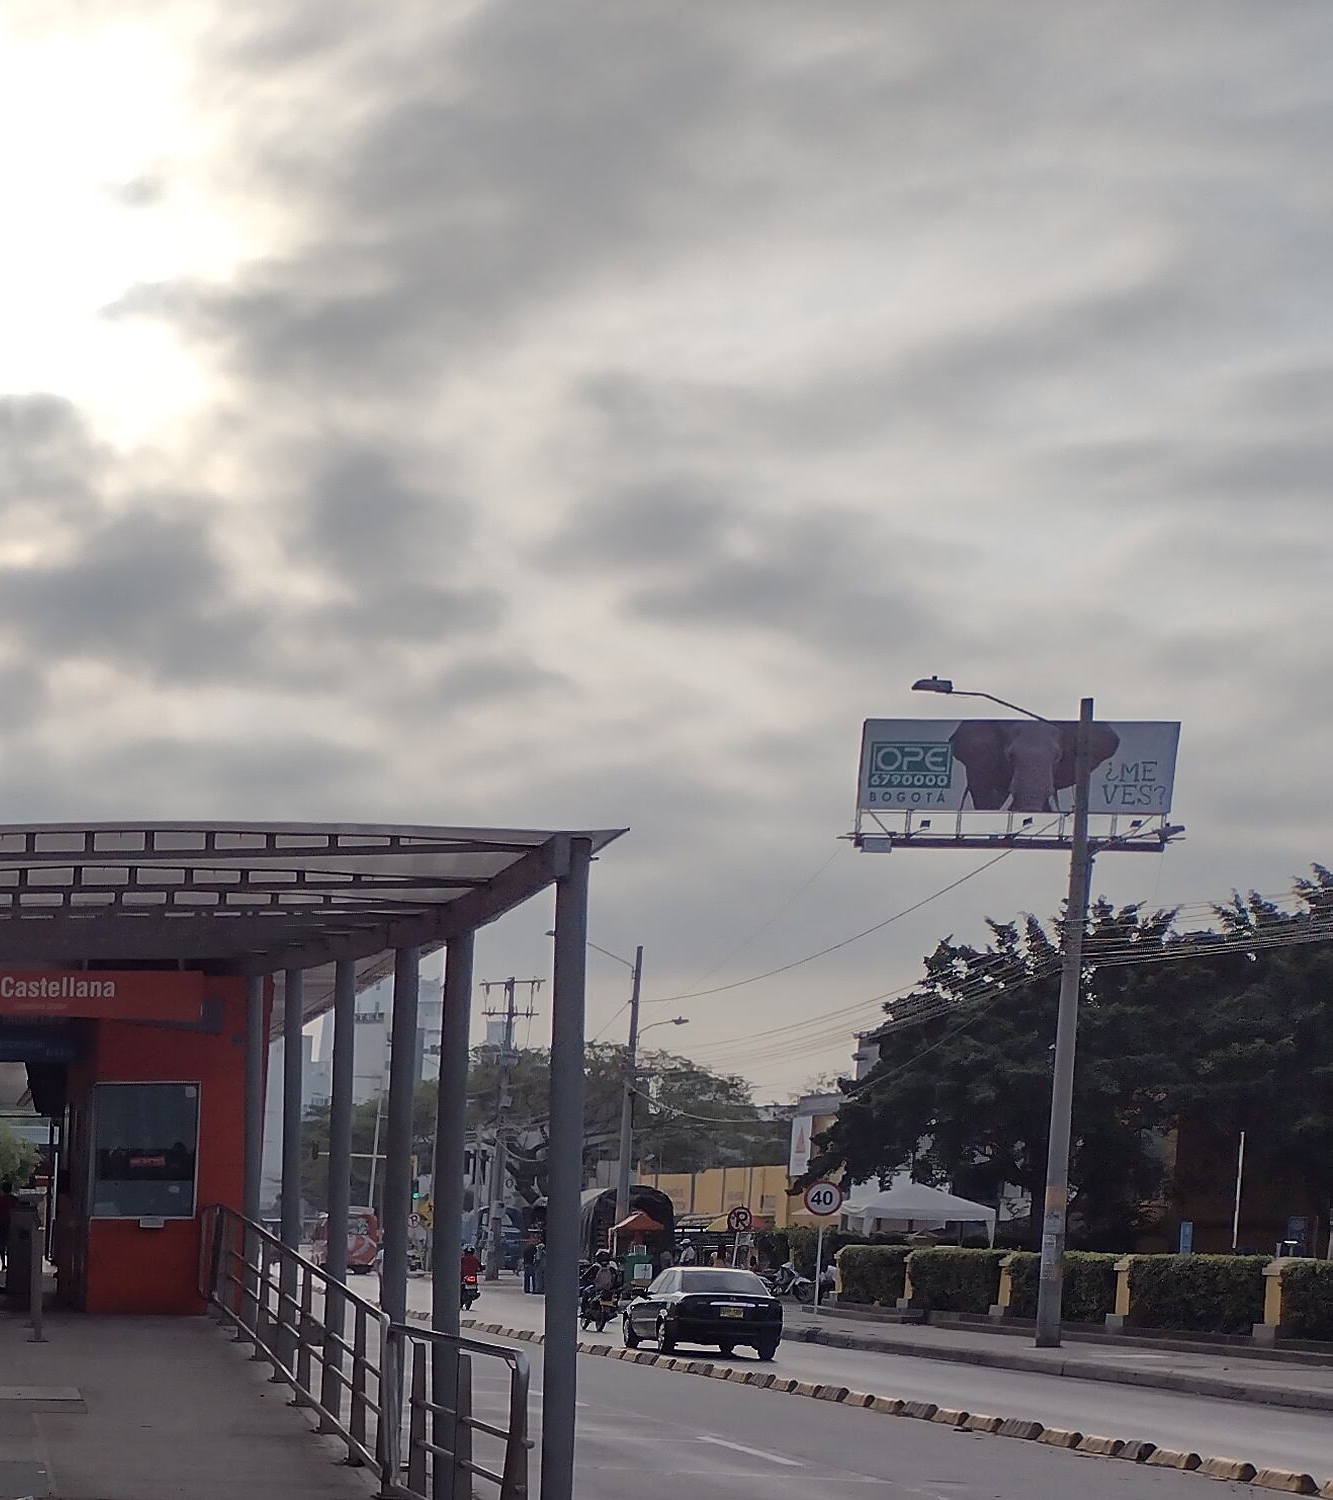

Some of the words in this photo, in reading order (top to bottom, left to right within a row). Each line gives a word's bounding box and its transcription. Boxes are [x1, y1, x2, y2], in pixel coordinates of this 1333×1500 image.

[876, 748, 950, 772] OPE
[870, 774, 948, 787] 6790000
[1104, 760, 1158, 782] ¿ME
[869, 789, 946, 803] BOGOTÁ
[1102, 784, 1166, 805] VES?
[0, 976, 116, 998] Castellana
[811, 1191, 833, 1206] 40
